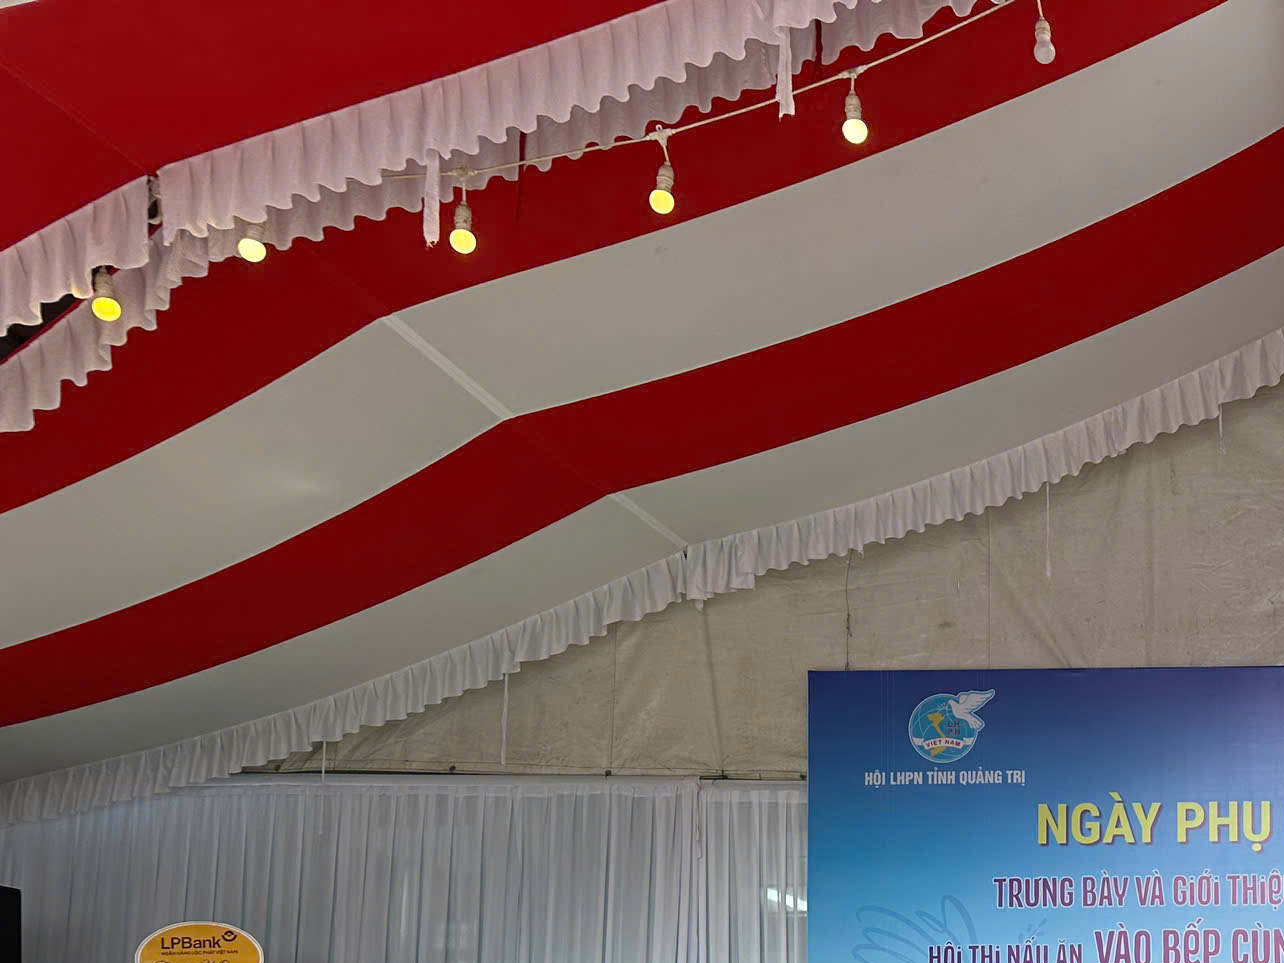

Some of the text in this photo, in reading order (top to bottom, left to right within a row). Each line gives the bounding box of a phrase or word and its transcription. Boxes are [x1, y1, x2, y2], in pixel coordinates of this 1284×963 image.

[945, 739, 961, 748] NAM
[865, 767, 1026, 788] HỘI LHPN TỈNH QUẢNG TRỊ
[1037, 791, 1162, 846] NGÀY
[1176, 800, 1273, 852] PHỤ
[993, 875, 1075, 909] TRƯNG
[1082, 870, 1129, 908] BÀY
[1135, 870, 1166, 906] VÀ
[160, 935, 222, 950] LPBank
